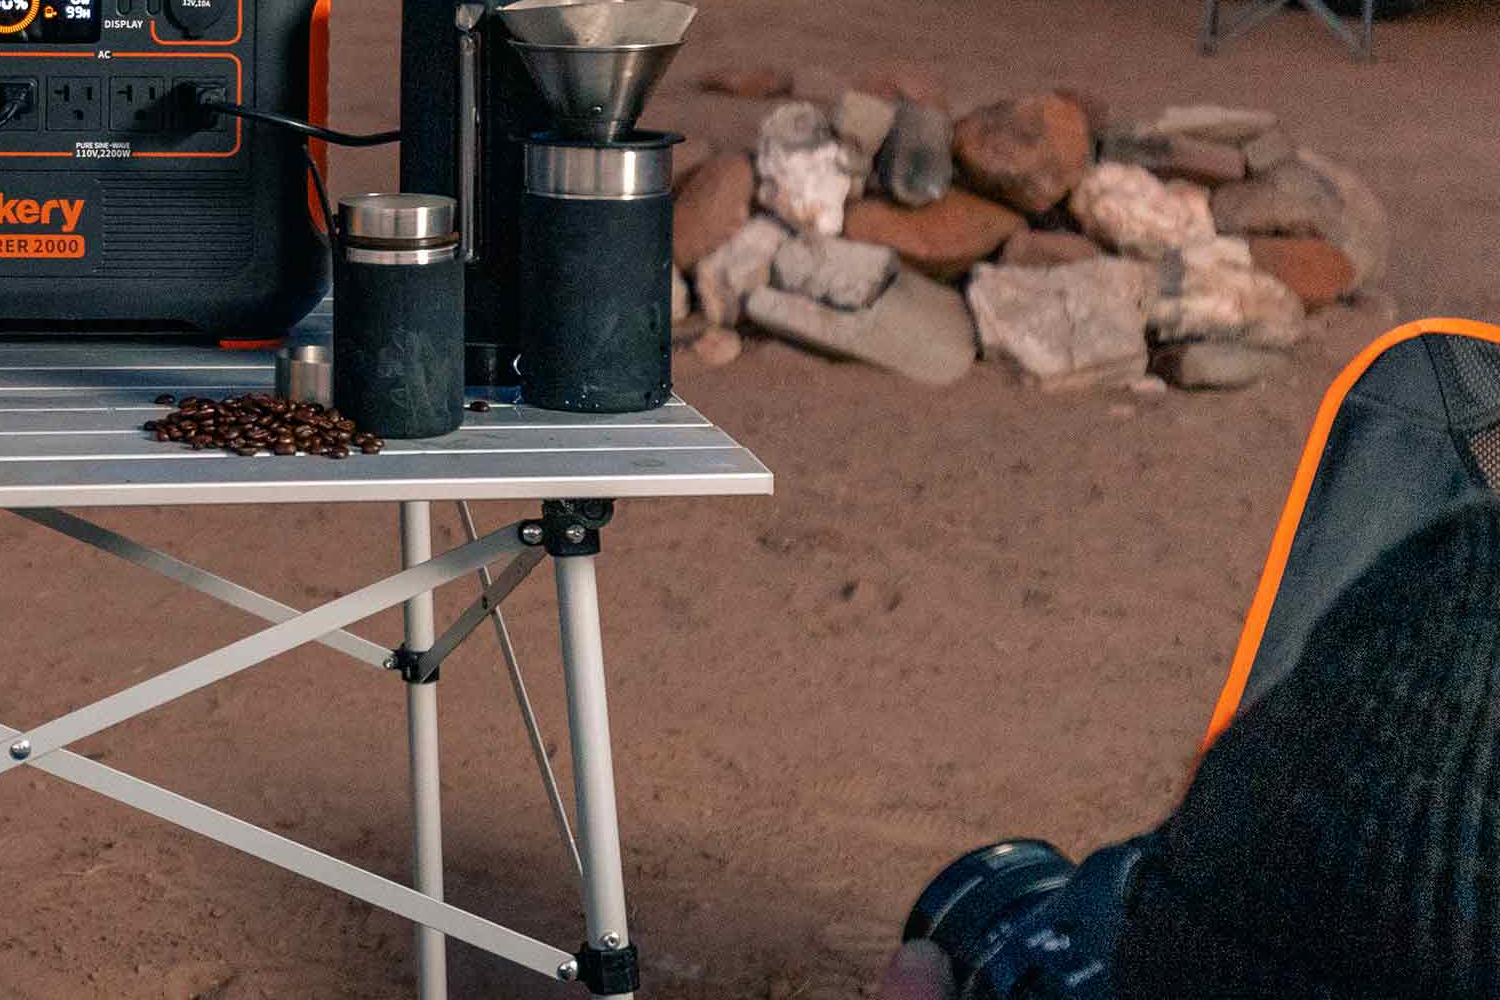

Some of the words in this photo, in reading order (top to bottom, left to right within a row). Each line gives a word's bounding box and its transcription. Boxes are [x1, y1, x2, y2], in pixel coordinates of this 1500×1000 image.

[104, 19, 144, 30] DISPLAY
[98, 50, 111, 59] AC
[34, 238, 79, 254] 2000
